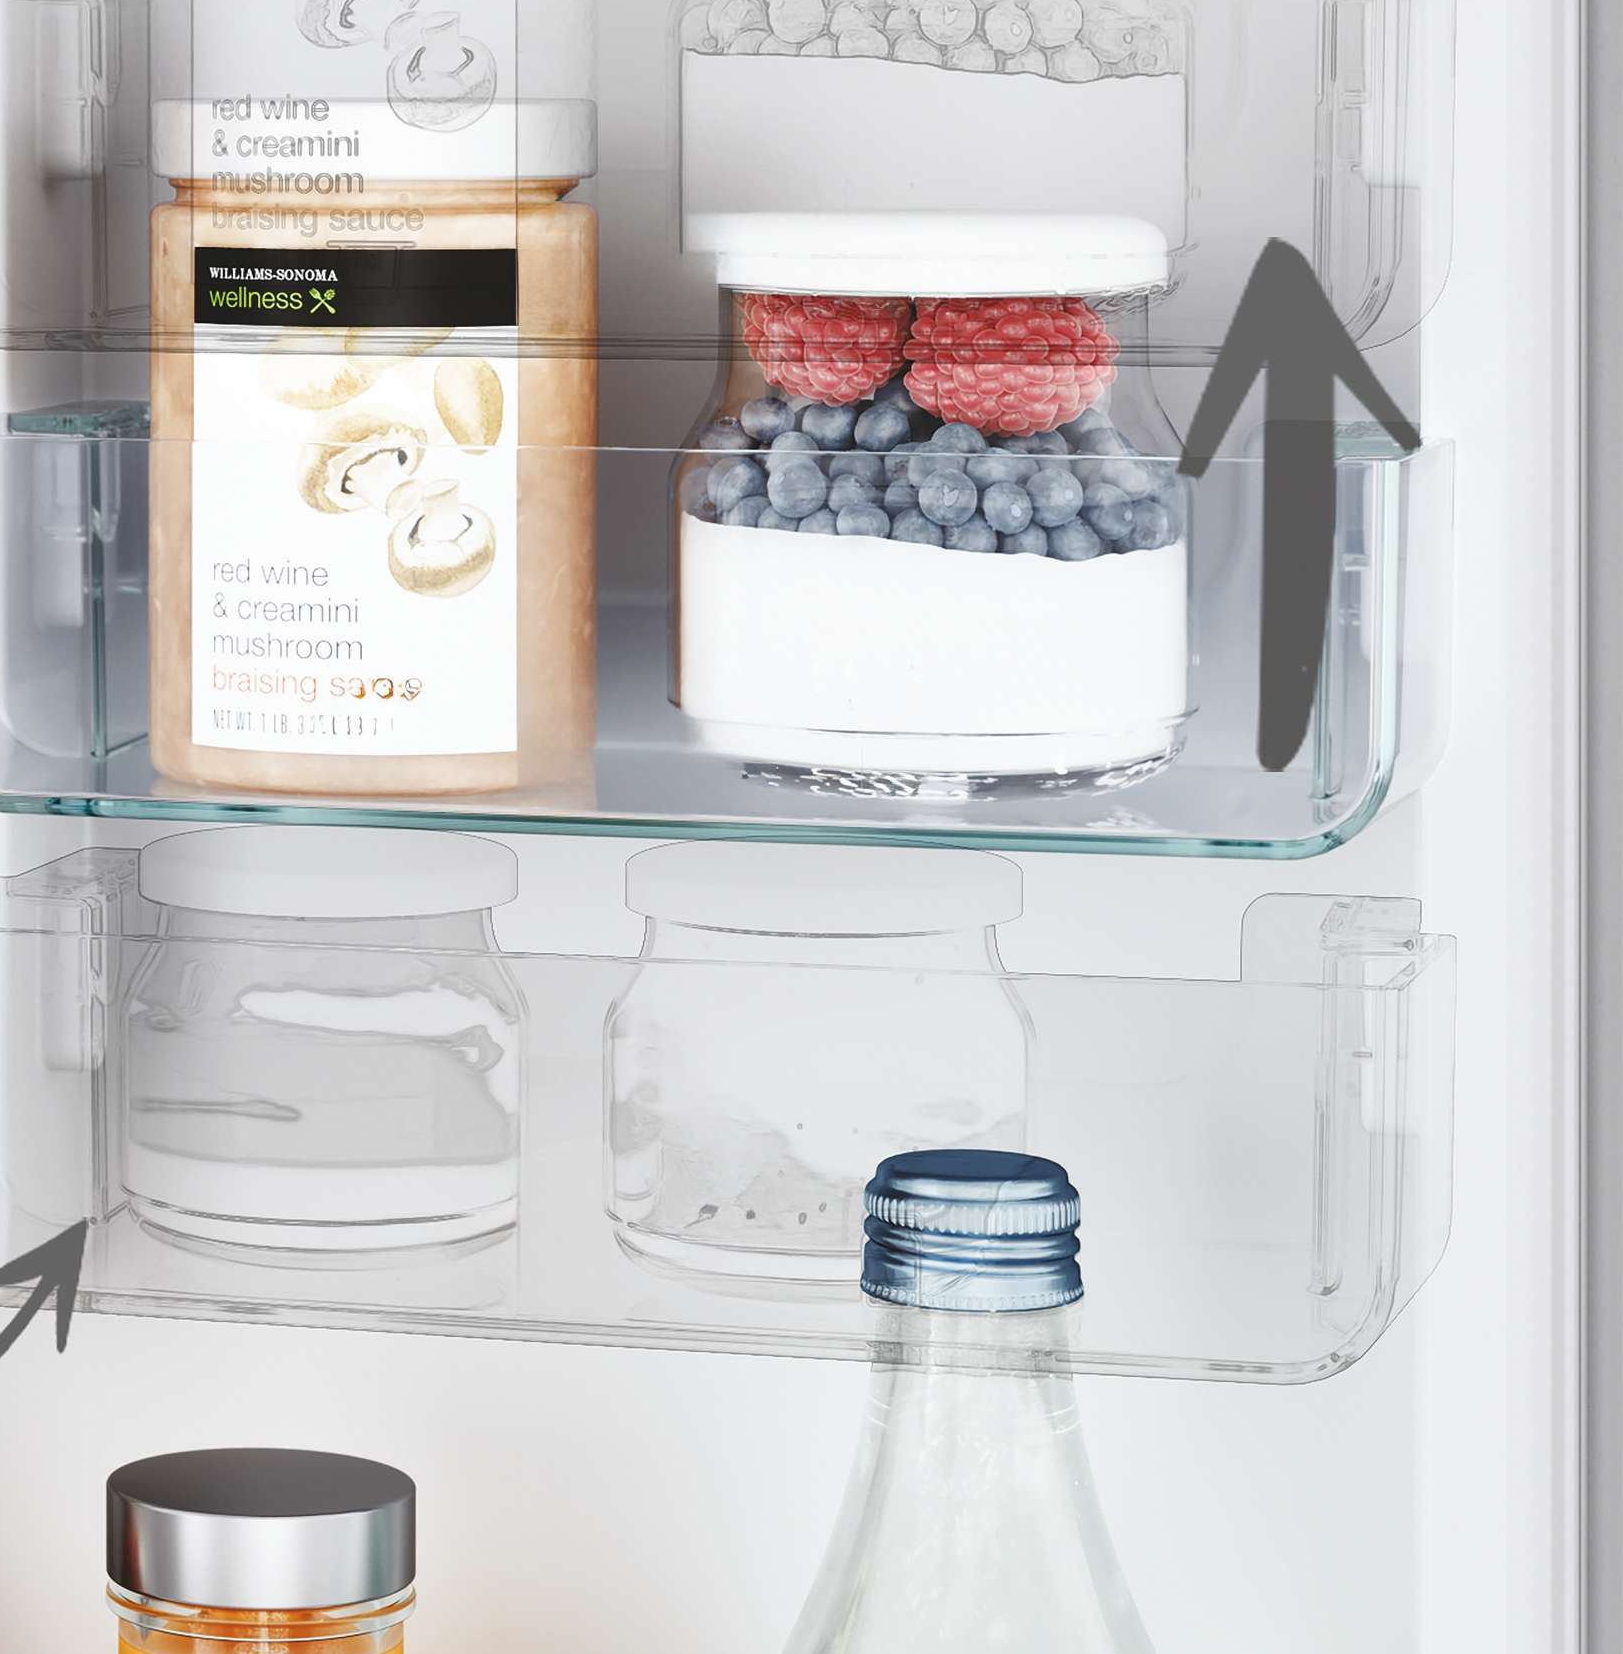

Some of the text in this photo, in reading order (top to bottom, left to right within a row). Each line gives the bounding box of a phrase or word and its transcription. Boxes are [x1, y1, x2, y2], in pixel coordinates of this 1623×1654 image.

[212, 93, 330, 122] red wine
[212, 128, 360, 158] & creamini
[212, 165, 365, 195] mushroom
[212, 201, 424, 238] braising sauce
[209, 266, 339, 283] WILLIAMS-SONOMA
[209, 286, 303, 310] wellness
[213, 558, 329, 587] red wine
[212, 591, 359, 623] & creamini
[212, 632, 364, 660] mushroom
[213, 663, 318, 703] braising
[213, 708, 231, 730] NET
